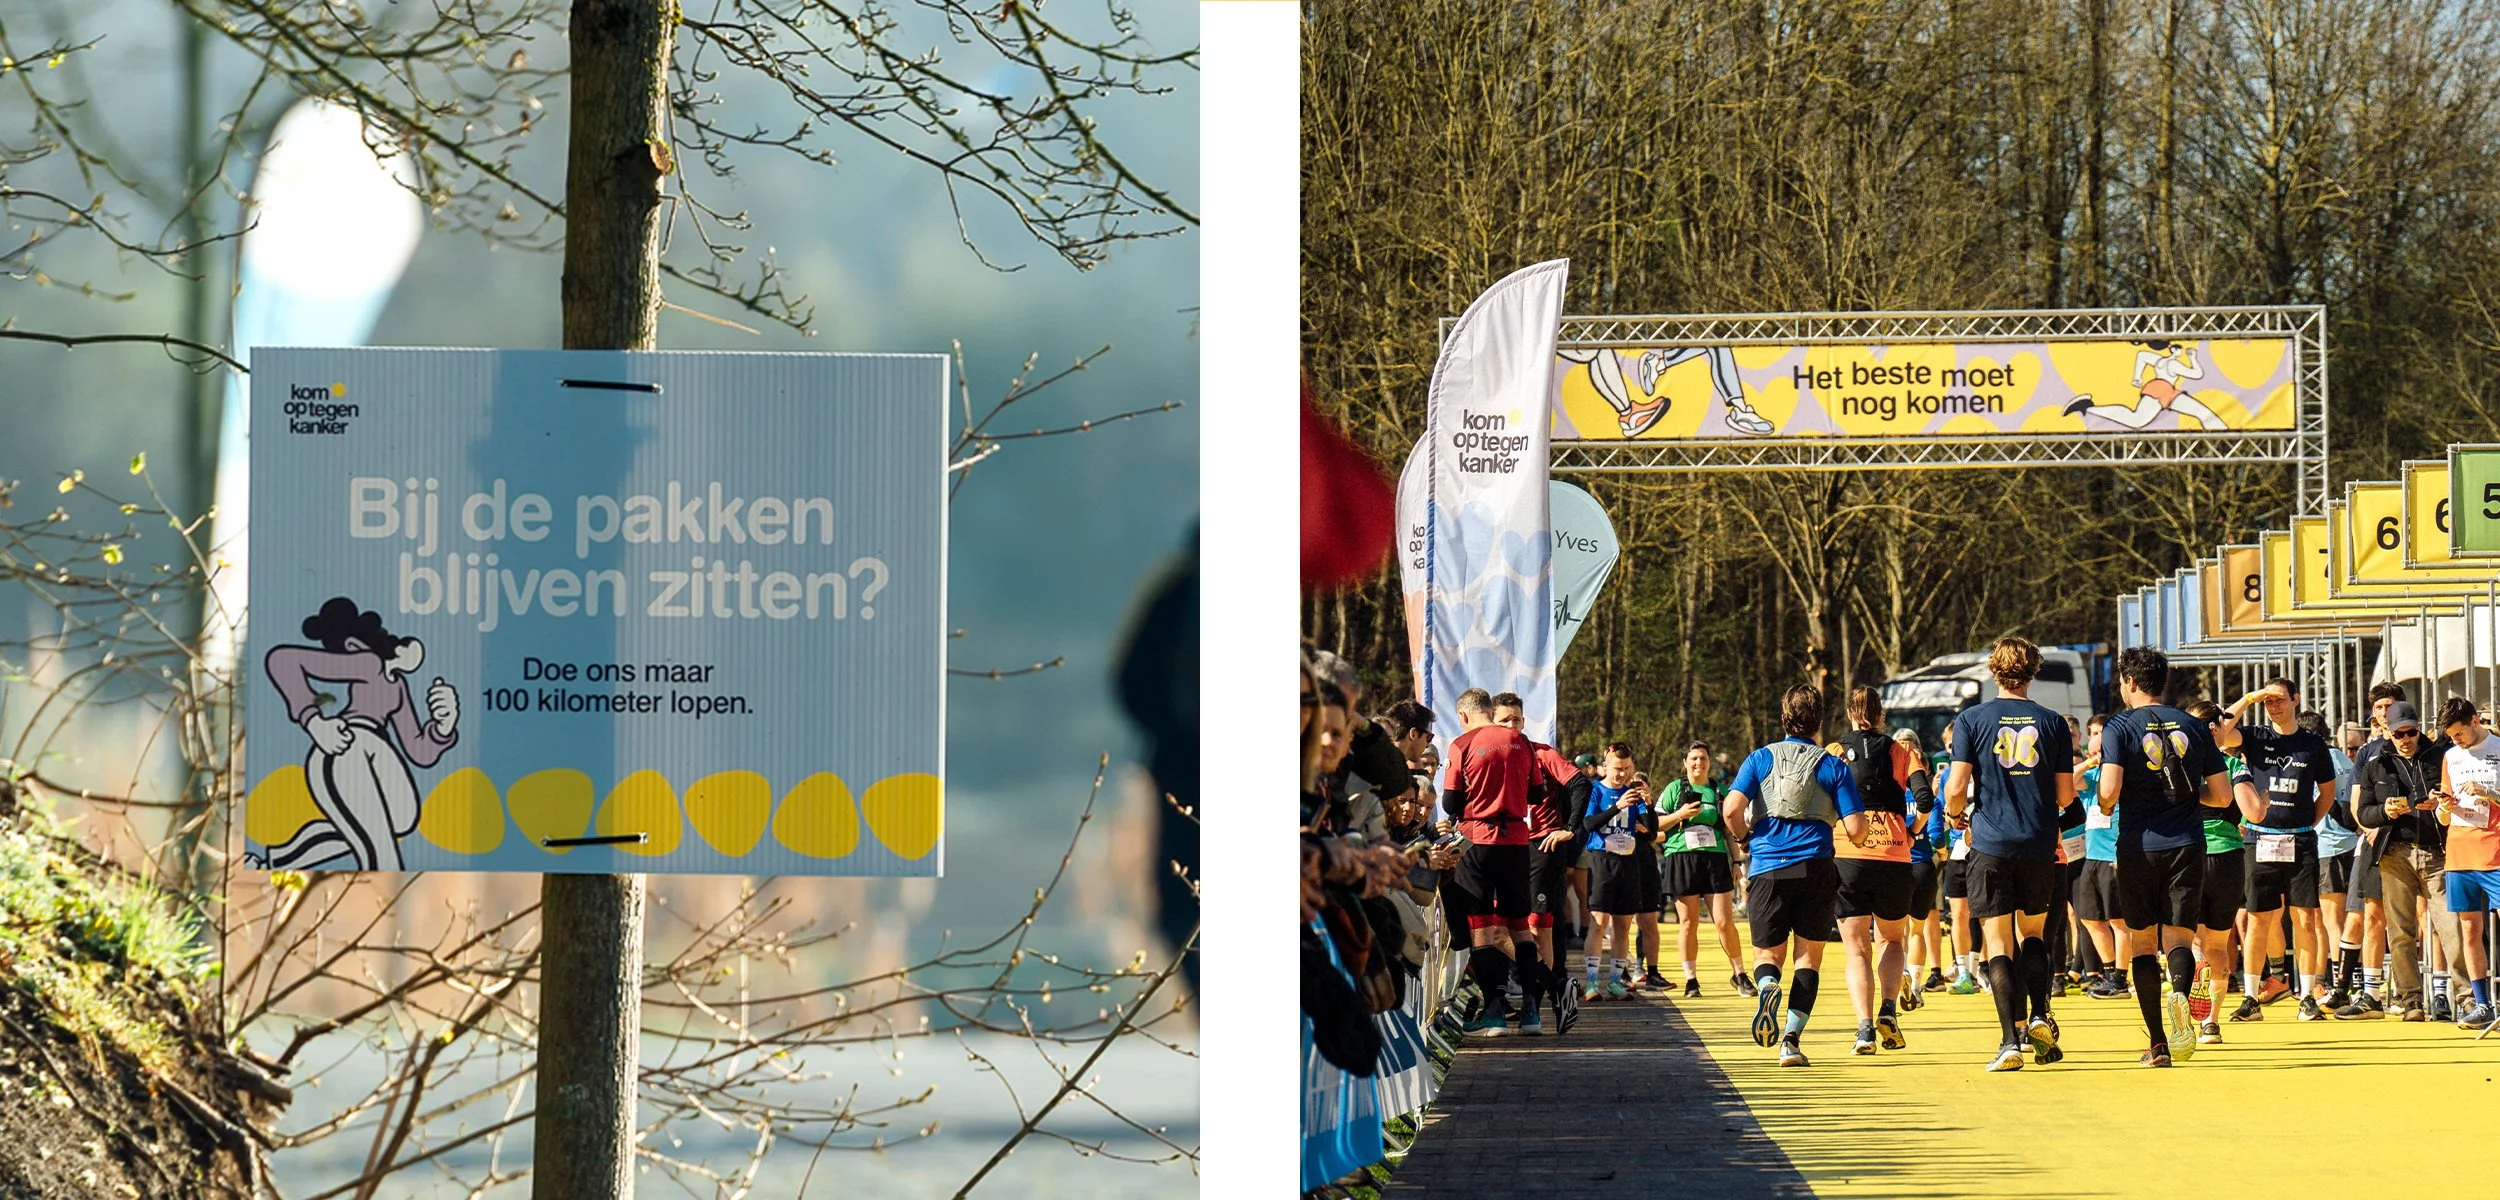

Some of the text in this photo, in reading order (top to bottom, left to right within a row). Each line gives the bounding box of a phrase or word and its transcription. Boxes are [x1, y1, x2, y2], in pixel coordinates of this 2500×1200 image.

[1793, 361, 2014, 389] Het beste moet
[291, 383, 329, 400] kom
[1842, 390, 2003, 421] nog komen
[290, 418, 349, 434] kanker
[1463, 409, 1505, 431] kom
[1459, 453, 1519, 474] kanker
[350, 477, 835, 558] Bij de pakken
[1413, 523, 1425, 538] ko
[1555, 530, 1598, 553] Yves
[2376, 516, 2401, 550] 6
[399, 552, 889, 633] blijven zitten?
[2244, 574, 2261, 602] 8
[523, 657, 714, 683] Doe ons maar
[482, 688, 754, 719] 100 kilometer lopen.
[2265, 757, 2277, 765] Een
[2268, 776, 2298, 793] LEO
